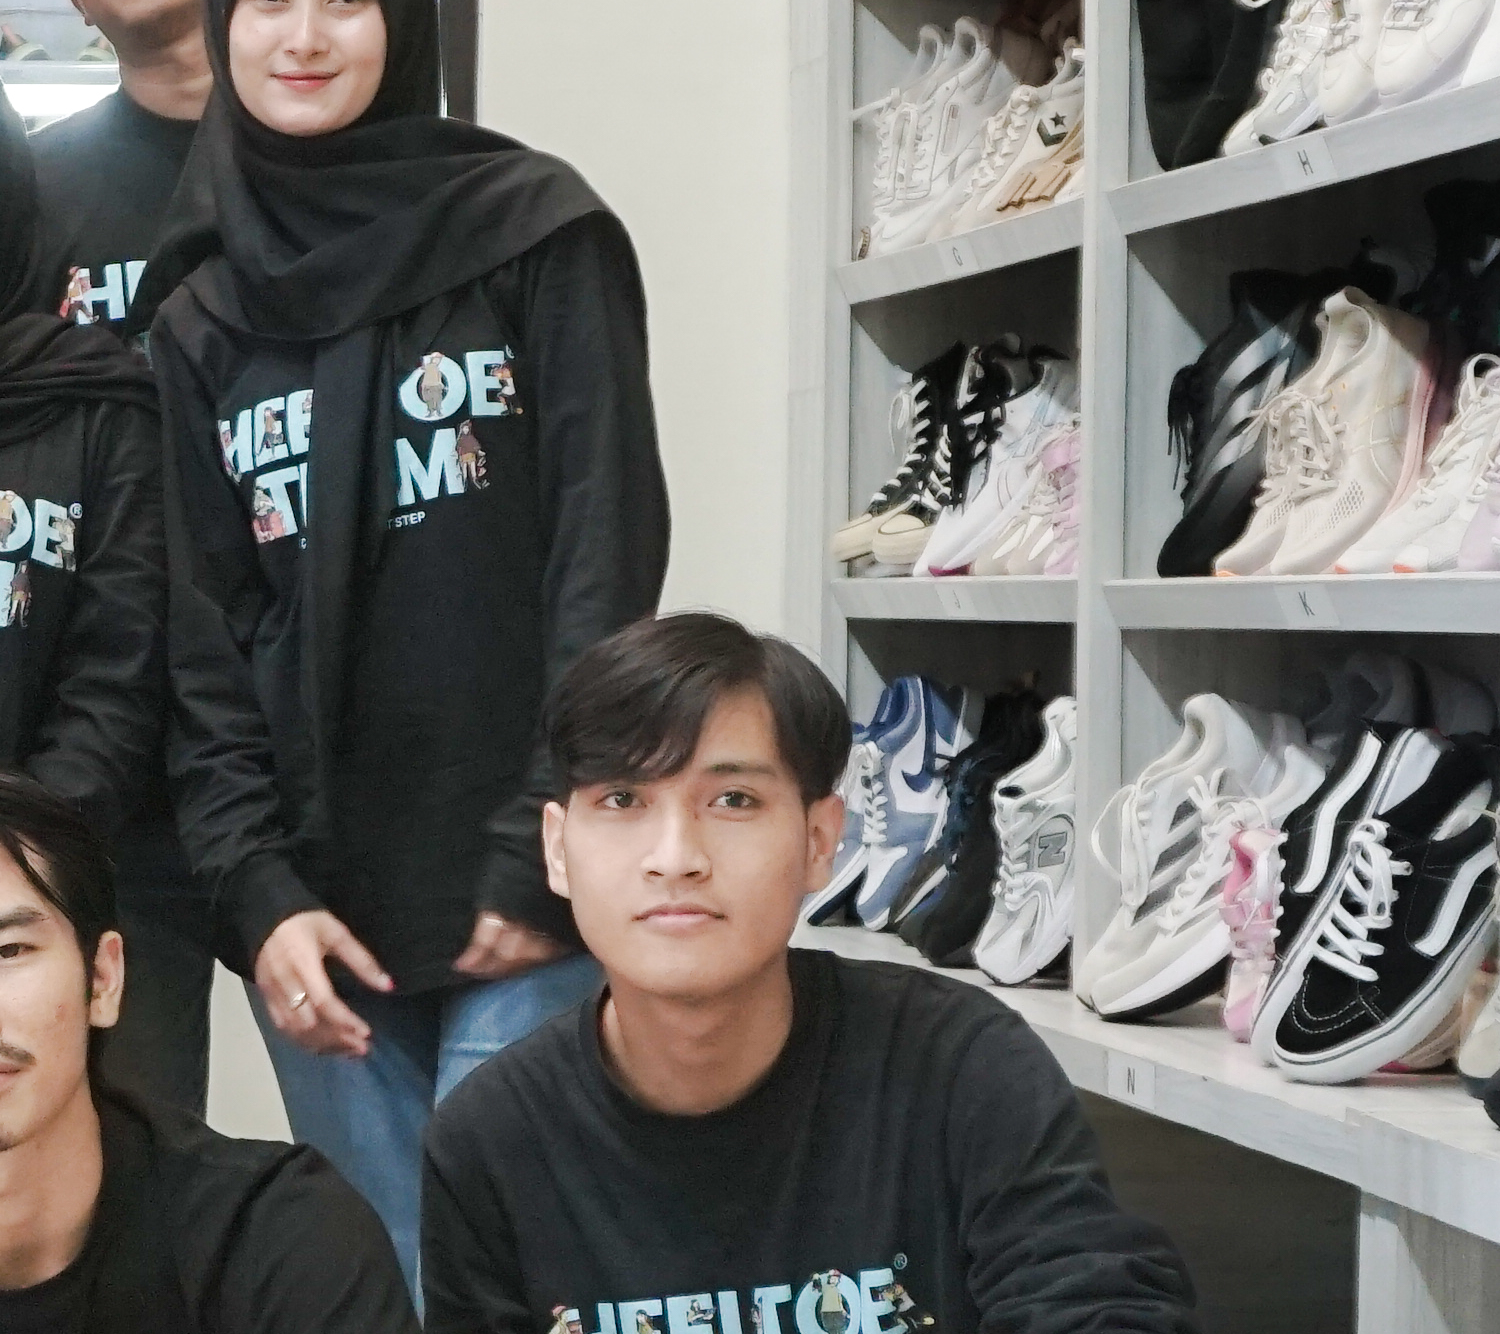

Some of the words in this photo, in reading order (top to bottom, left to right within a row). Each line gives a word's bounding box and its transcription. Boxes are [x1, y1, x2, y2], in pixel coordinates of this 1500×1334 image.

[1297, 150, 1313, 175] H
[395, 511, 426, 528] STEP
[1298, 591, 1315, 616] K
[1127, 1066, 1136, 1095] N
